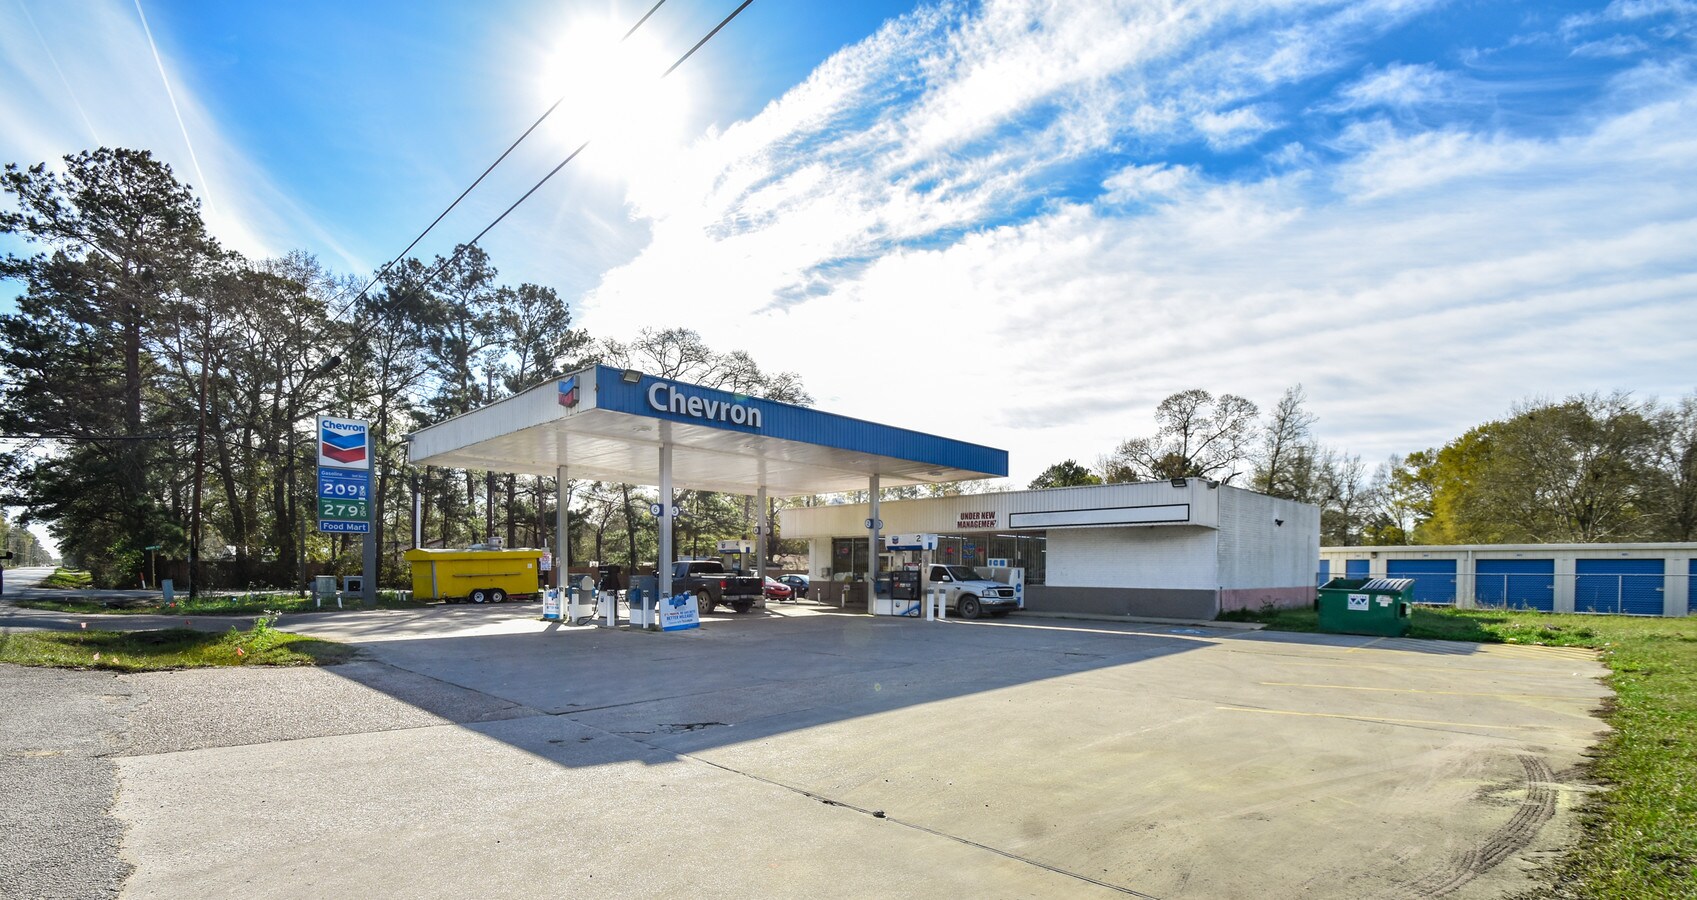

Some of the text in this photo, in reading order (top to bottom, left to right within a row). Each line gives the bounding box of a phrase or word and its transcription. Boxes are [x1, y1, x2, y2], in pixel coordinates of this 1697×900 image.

[648, 382, 761, 427] Chevron
[322, 420, 365, 432] Chevron
[323, 483, 358, 496] 209
[324, 504, 358, 517] 279
[960, 511, 996, 520] UNDER NEW
[323, 522, 366, 531] Food Mart
[916, 535, 921, 543] 2
